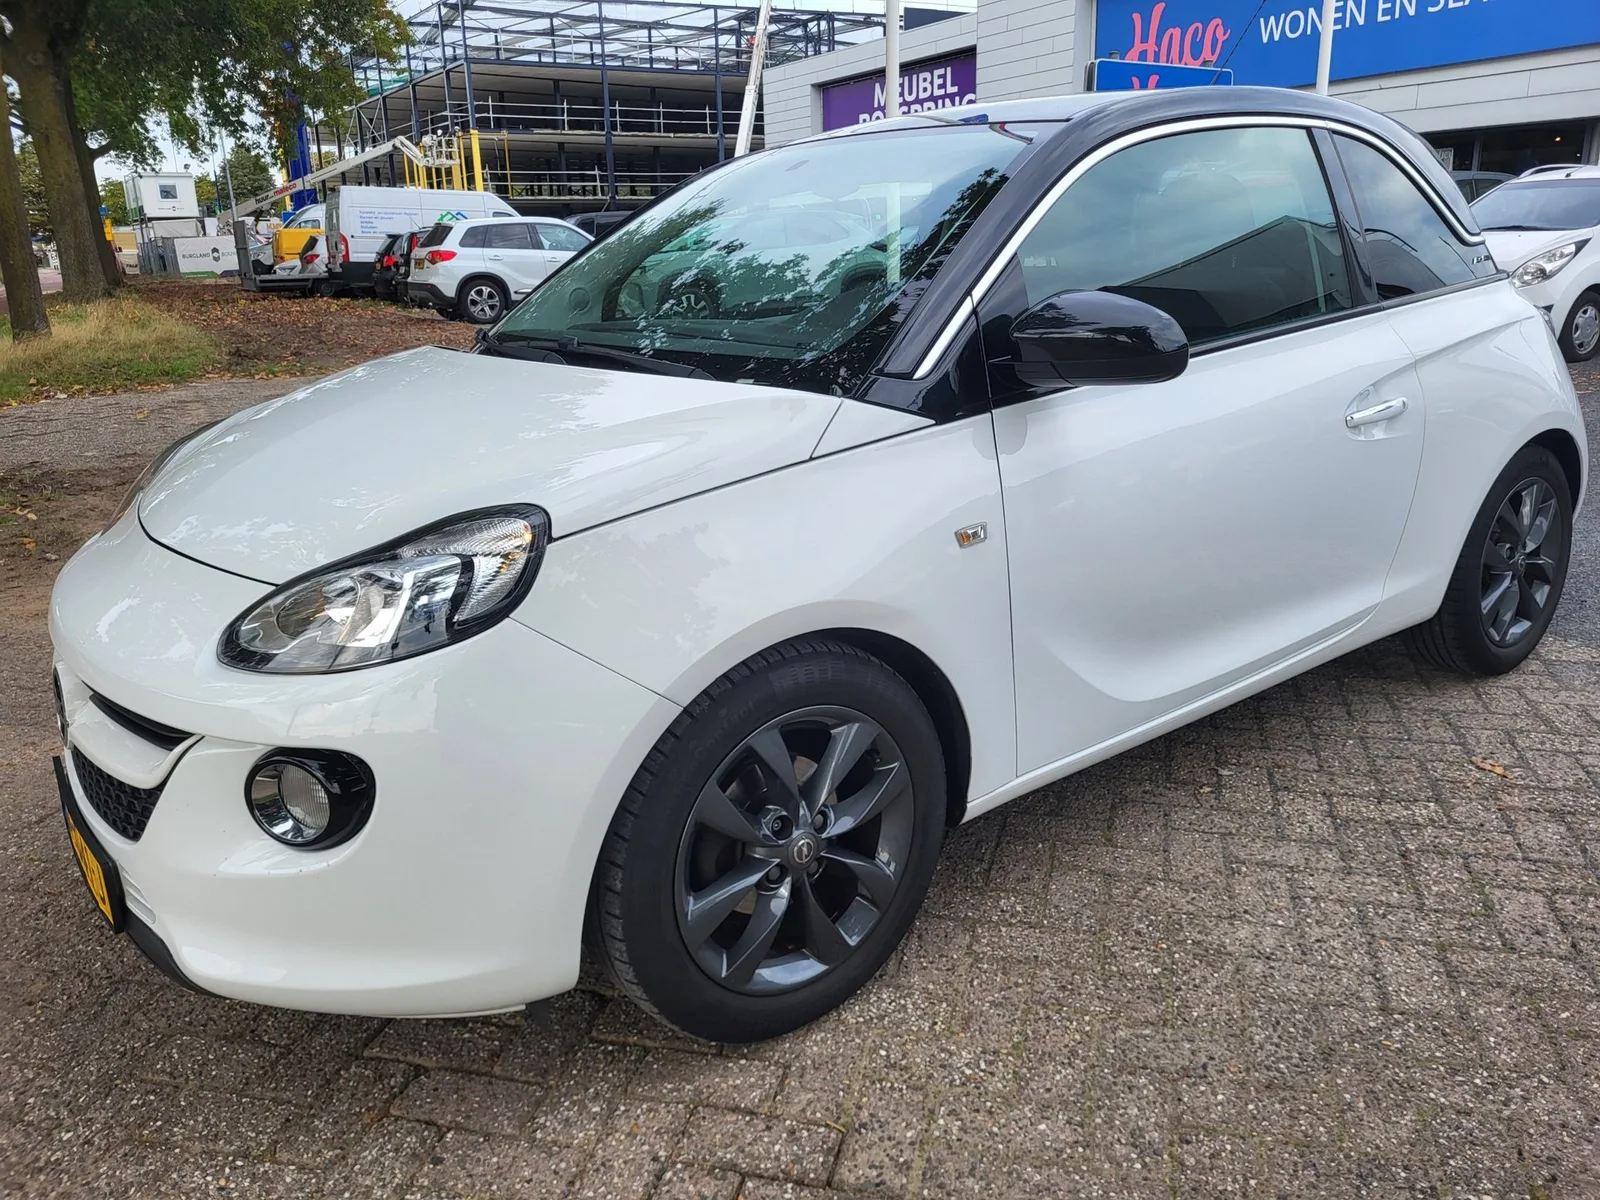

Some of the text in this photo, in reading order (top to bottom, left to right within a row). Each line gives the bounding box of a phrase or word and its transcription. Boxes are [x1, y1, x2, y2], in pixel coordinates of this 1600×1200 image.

[1124, 2, 1231, 67] Haco
[1259, 0, 1416, 43] WONEN EN
[873, 66, 959, 108] MEUBEL
[273, 182, 297, 197] mateco
[181, 252, 211, 260] BURGLAND
